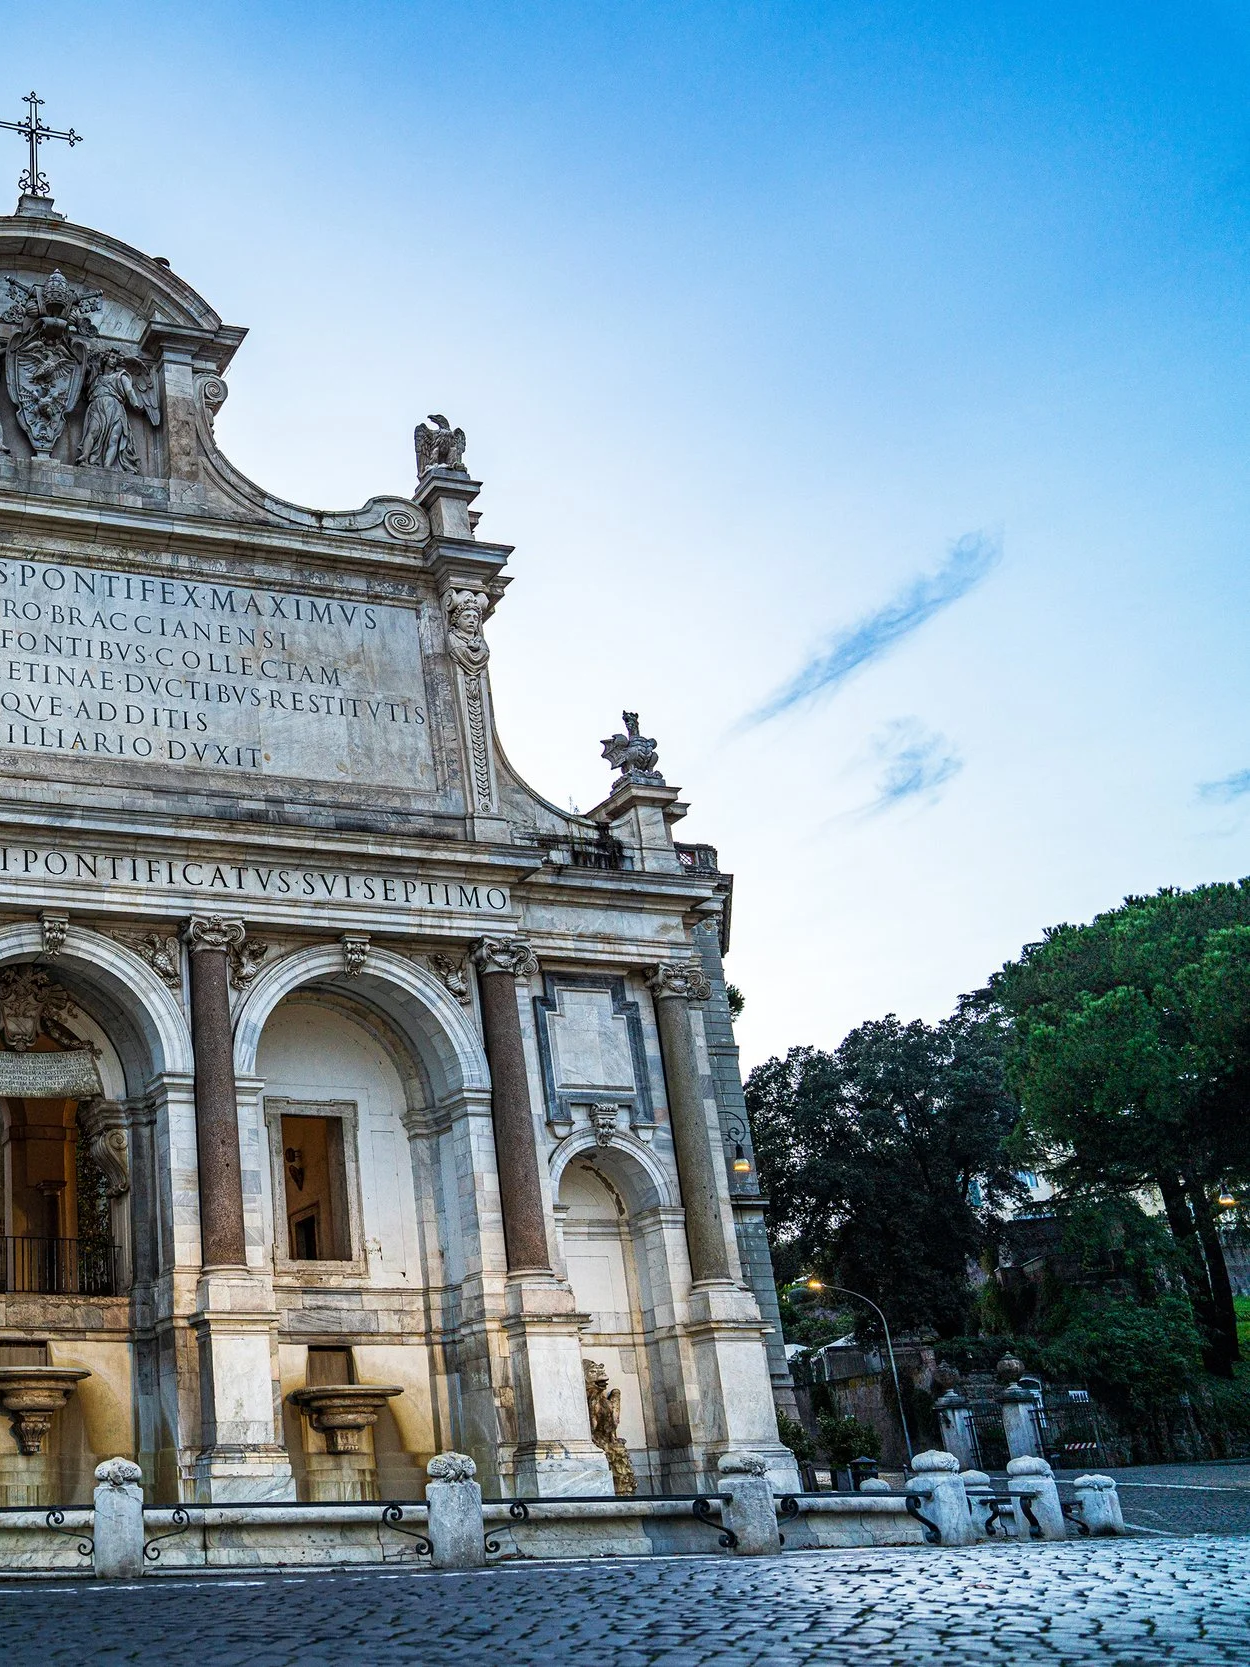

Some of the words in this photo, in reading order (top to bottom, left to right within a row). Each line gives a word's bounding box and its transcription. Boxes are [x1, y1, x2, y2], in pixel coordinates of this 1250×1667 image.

[19, 564, 202, 609] PONTIFEX
[209, 587, 377, 630] MAXIMVS
[51, 605, 287, 651] BRACCIANENSI
[1, 629, 146, 664] FONTIBVS
[156, 648, 342, 687] COLLECTAM
[73, 700, 208, 732] ADDITIS
[123, 673, 262, 707] DVCTIBVS
[269, 689, 426, 726] RESTITVTIS
[167, 740, 262, 768] DVXIT
[22, 849, 292, 893] PONTIFICATVS
[302, 872, 354, 898] SVI
[363, 877, 508, 910] SEPTIMO
